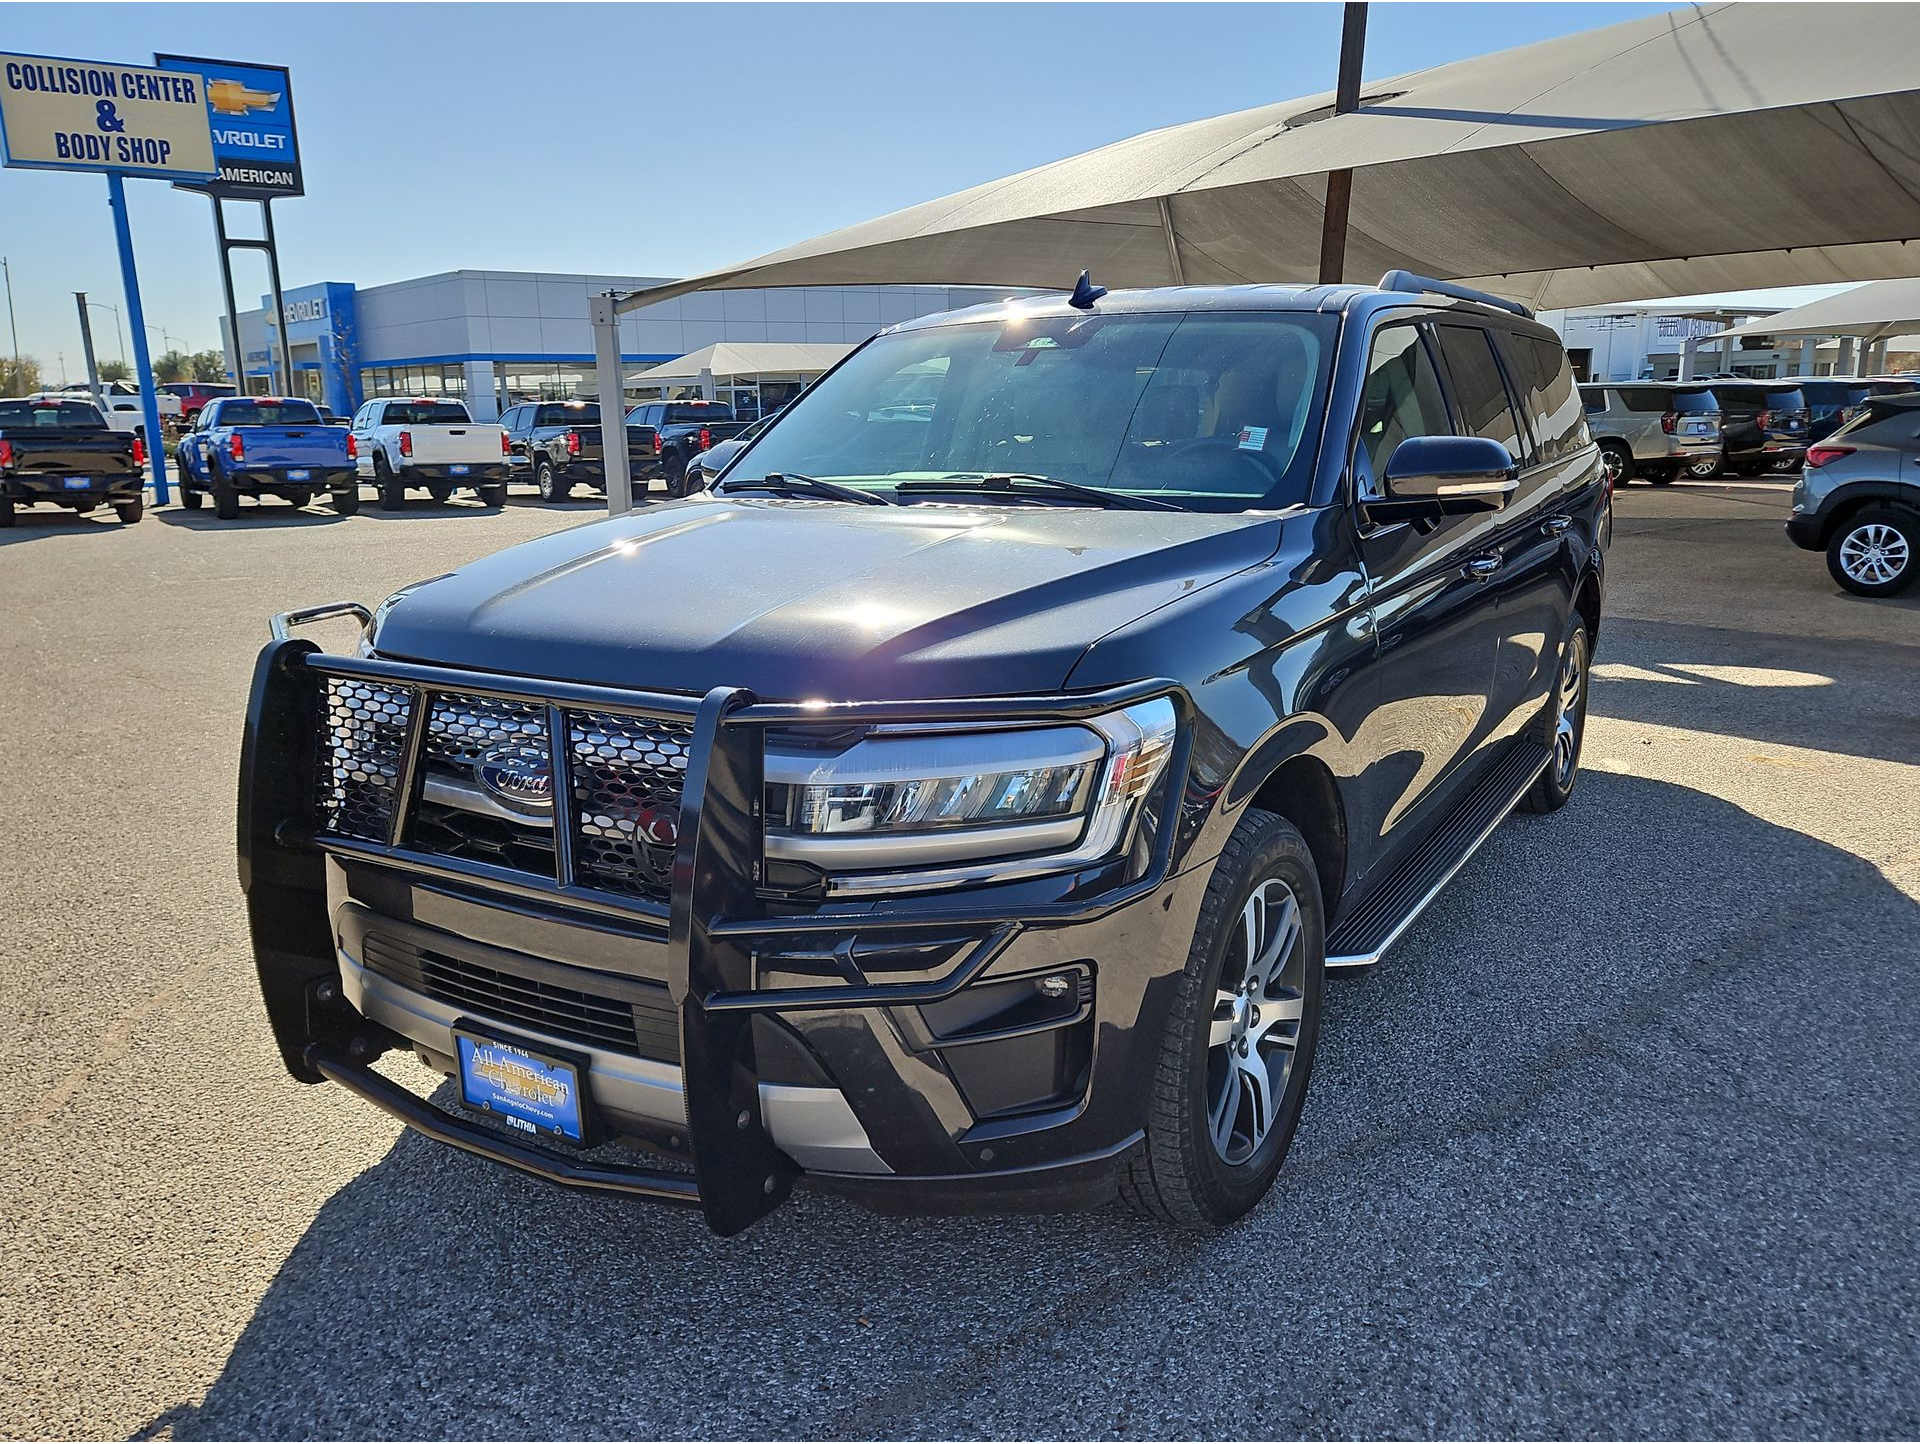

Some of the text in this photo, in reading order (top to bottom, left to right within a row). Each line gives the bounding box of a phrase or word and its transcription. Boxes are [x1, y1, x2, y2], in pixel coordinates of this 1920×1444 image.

[6, 62, 197, 104] COLLISION CENTER
[95, 99, 126, 133] &
[54, 131, 171, 165] BODY SHOP
[212, 129, 286, 149] VROLET
[216, 167, 294, 185] AMERICAN
[496, 768, 549, 795] Ford
[492, 1041, 513, 1054] SINCE
[472, 1047, 569, 1094] All American
[513, 1117, 537, 1135] LITHIA
